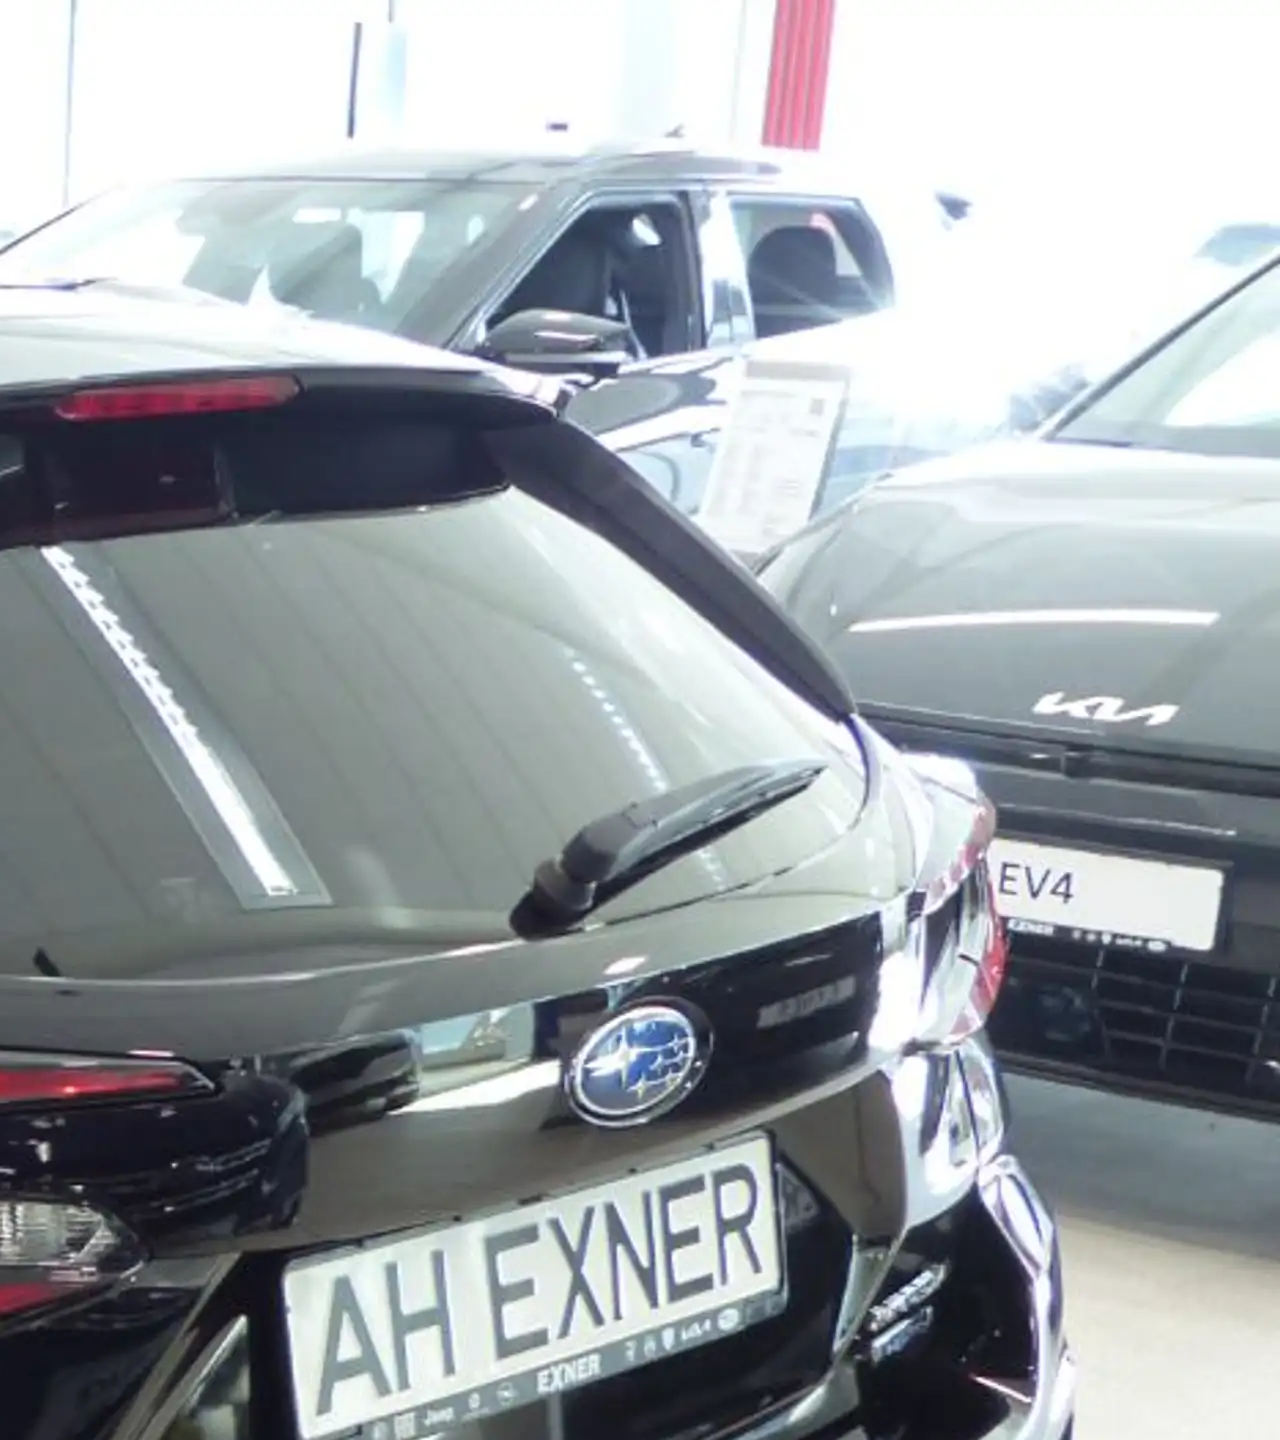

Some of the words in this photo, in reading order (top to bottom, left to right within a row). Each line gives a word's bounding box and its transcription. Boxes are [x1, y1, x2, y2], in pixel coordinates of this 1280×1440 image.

[1032, 691, 1180, 726] KIA
[998, 861, 1074, 904] EV4
[315, 1249, 456, 1417] AH
[483, 1162, 763, 1360] EXNER
[536, 1354, 601, 1395] EXNER
